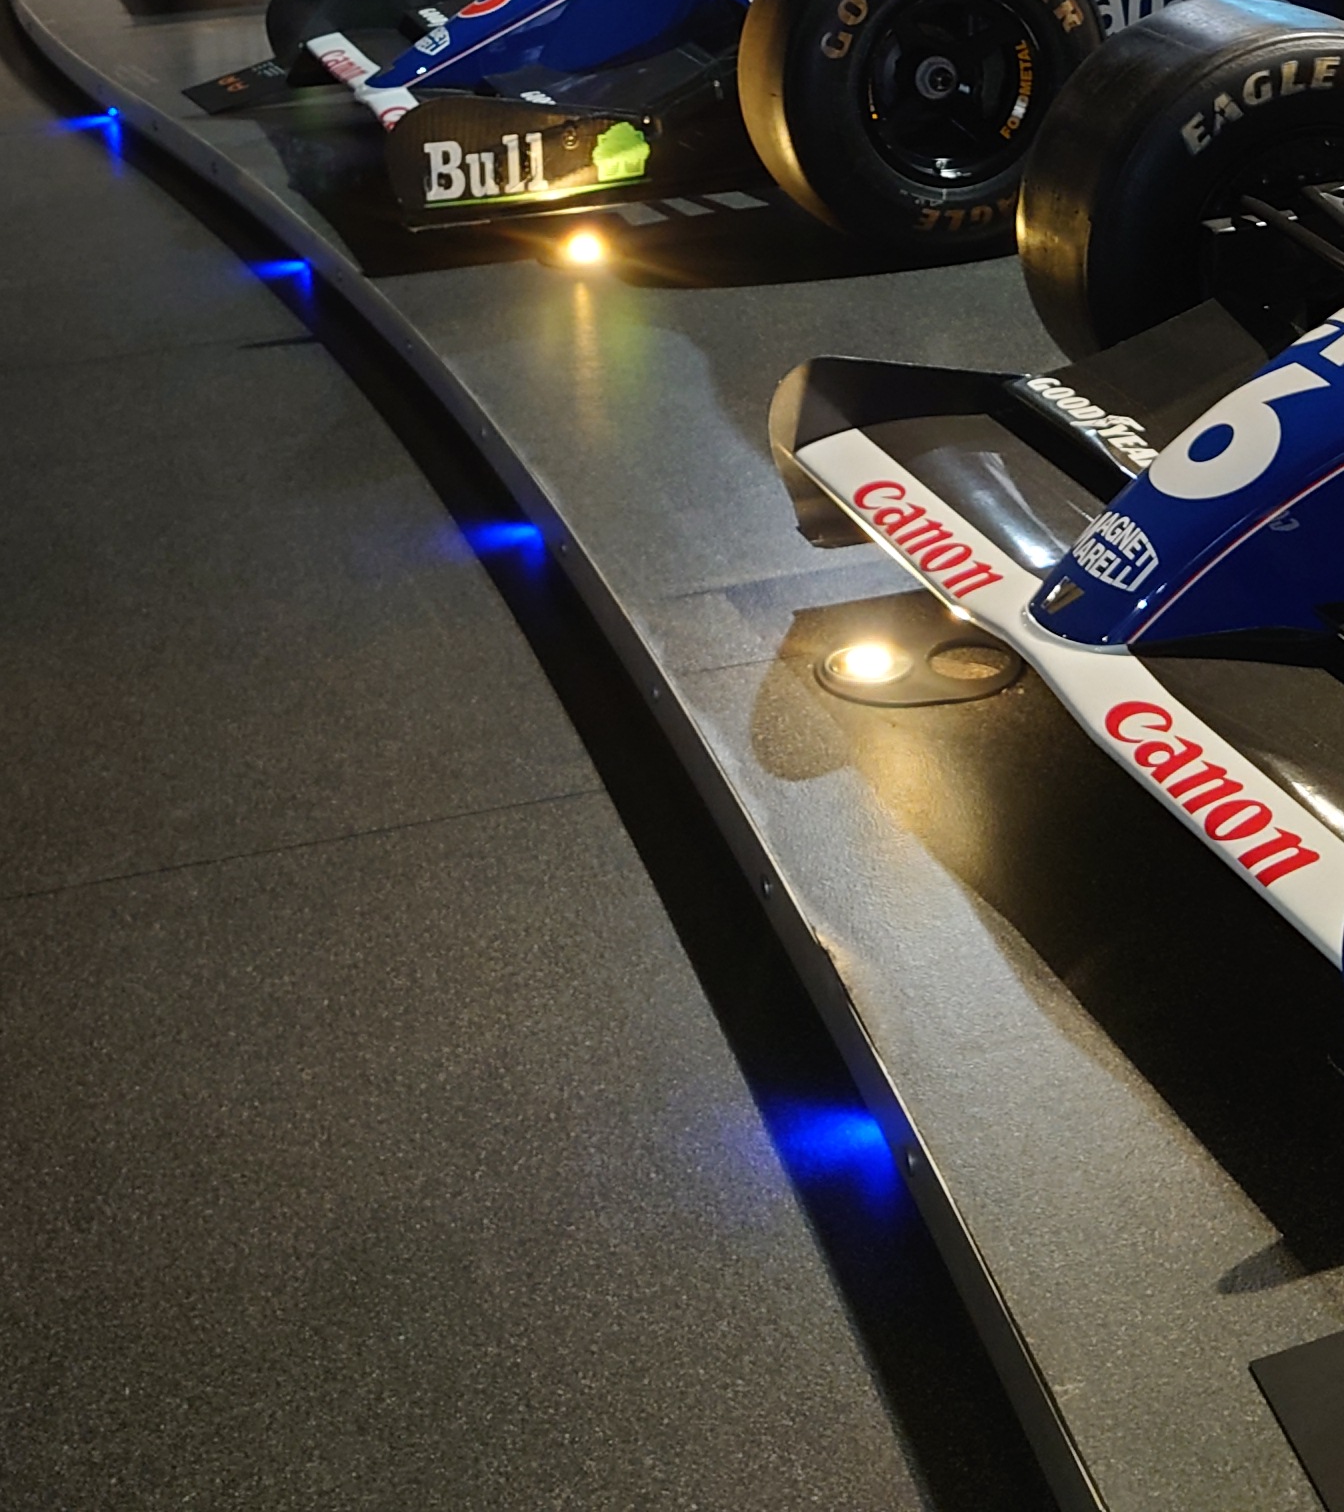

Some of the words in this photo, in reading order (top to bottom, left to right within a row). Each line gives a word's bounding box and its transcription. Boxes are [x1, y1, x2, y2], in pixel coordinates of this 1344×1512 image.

[999, 39, 1034, 140] FONDMETAL
[1180, 55, 1341, 156] EAGLE
[423, 132, 549, 203] Bull
[912, 189, 1019, 234] AGLE
[1147, 361, 1331, 501] 6
[853, 478, 1004, 601] Canon
[1104, 700, 1322, 887] Canon
